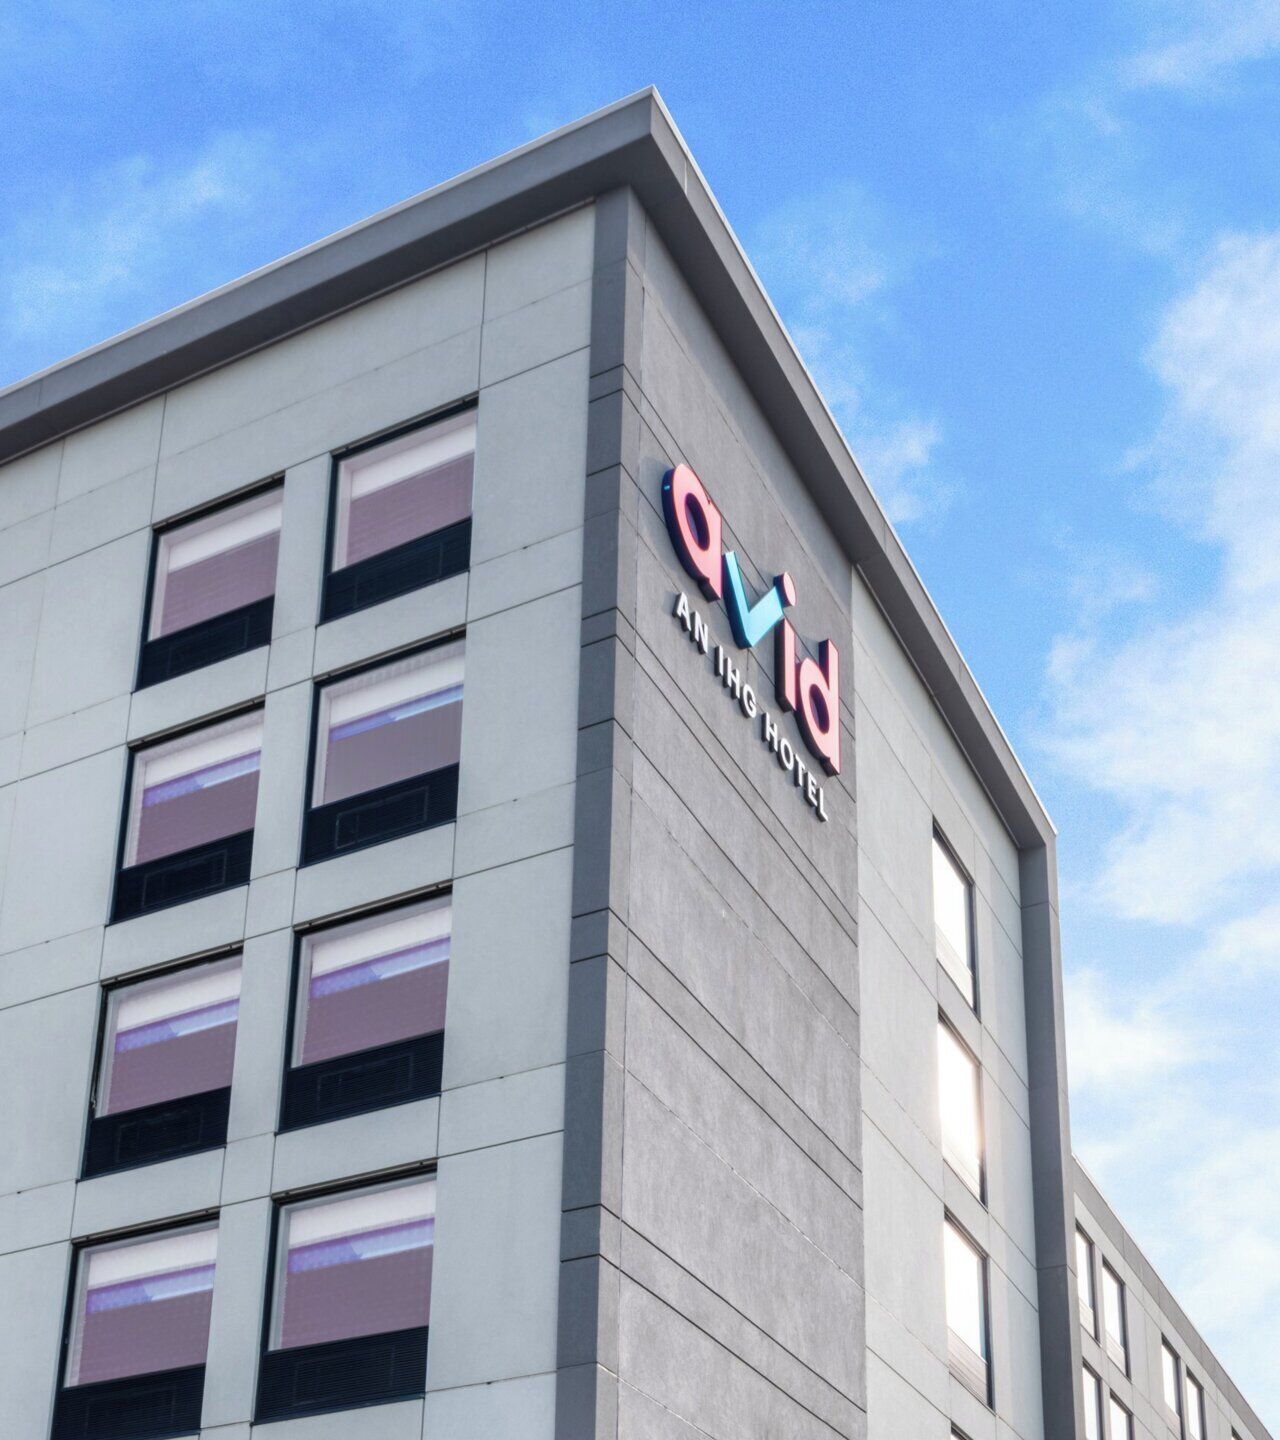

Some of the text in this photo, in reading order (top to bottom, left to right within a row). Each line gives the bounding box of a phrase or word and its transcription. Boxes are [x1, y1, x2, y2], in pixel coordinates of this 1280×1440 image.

[661, 463, 840, 777] avid
[673, 592, 830, 823] AN IHG HOTEL
